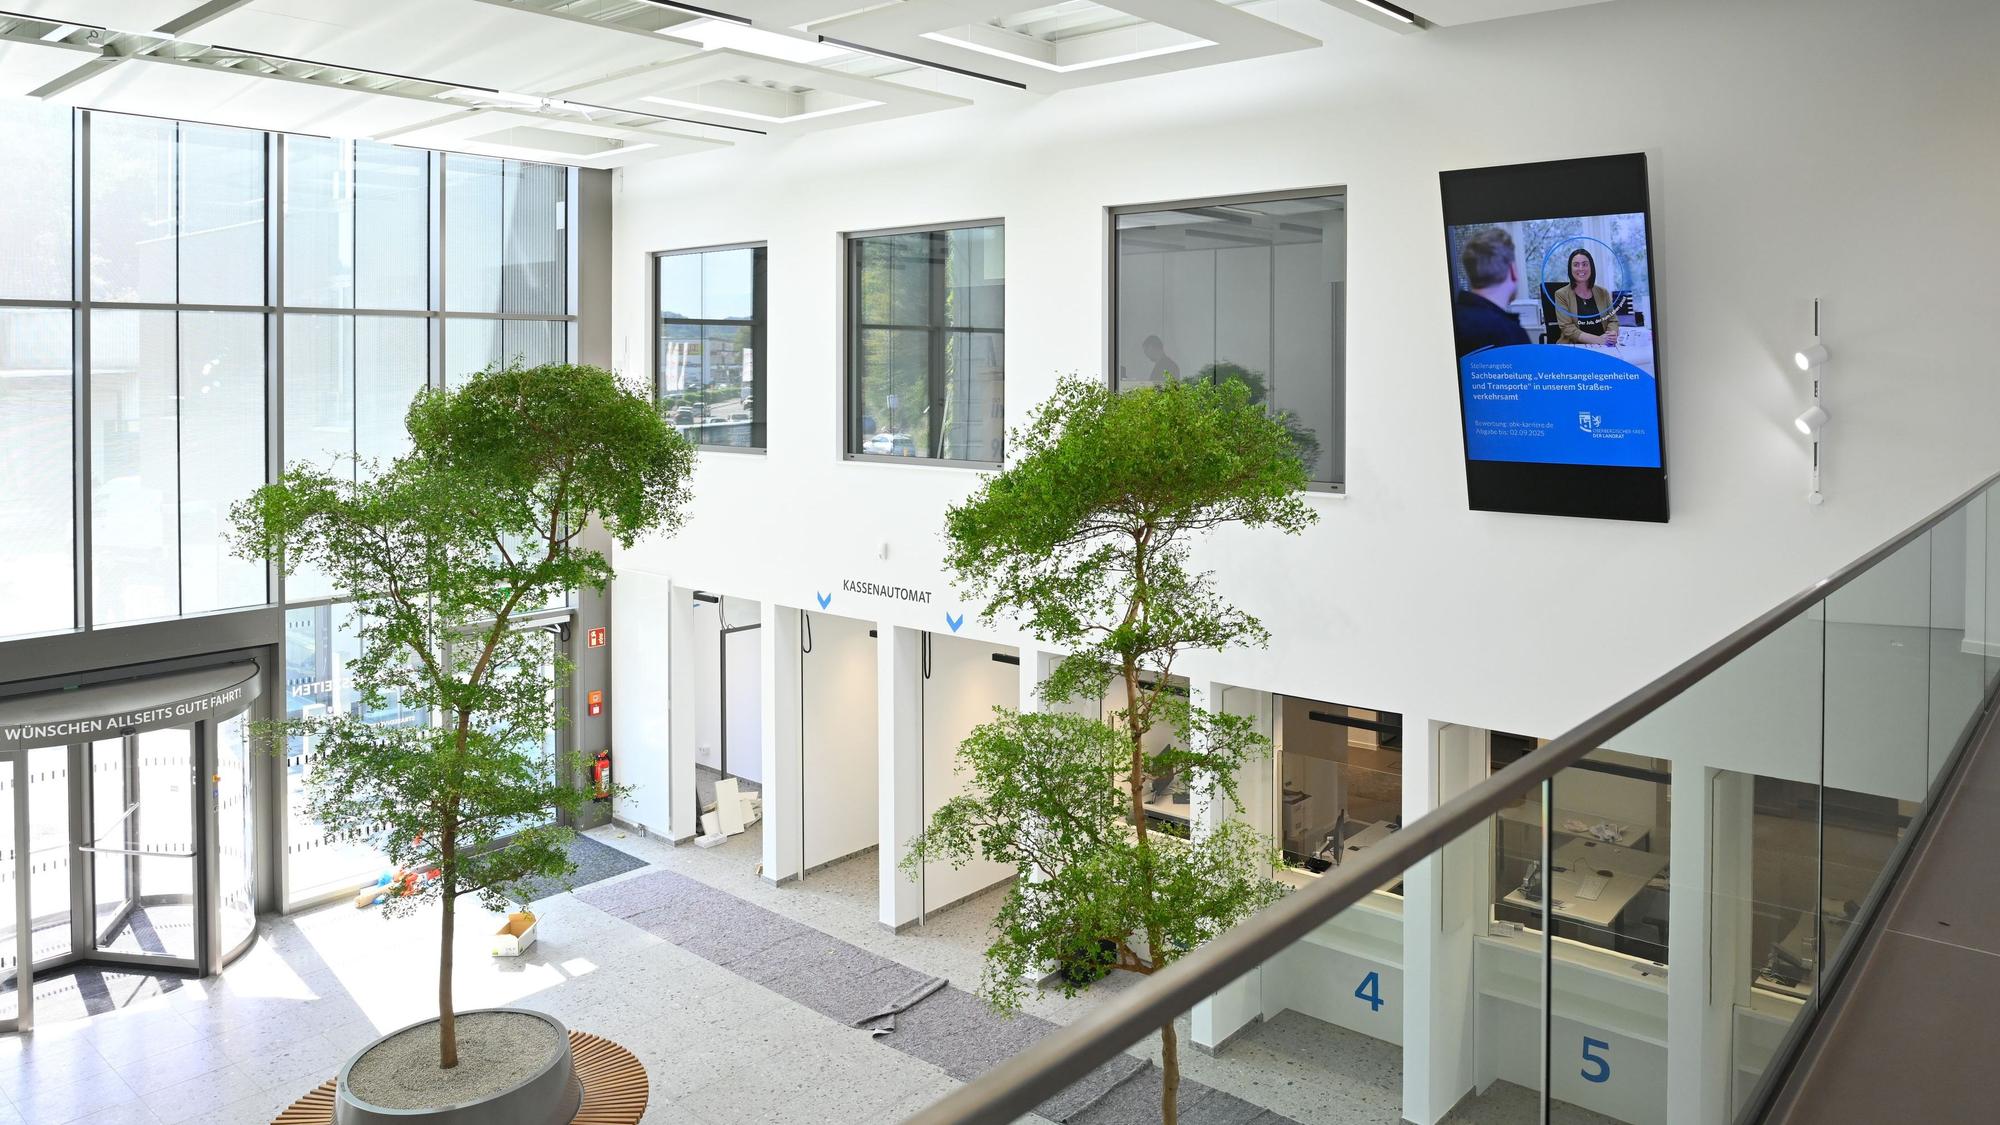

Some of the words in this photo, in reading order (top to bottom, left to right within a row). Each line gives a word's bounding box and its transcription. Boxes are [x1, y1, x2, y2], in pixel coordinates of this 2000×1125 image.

[1470, 362, 1513, 370] Stellenangebot
[1471, 371, 1533, 381] Sachbearbeitung
[1472, 382, 1486, 390] und
[1577, 383, 1613, 391] Straßen-
[1472, 393, 1519, 401] verkehrsamt
[843, 579, 932, 604] KASSENAUTOMAT
[4, 719, 102, 741] WÜNSCHEN
[106, 707, 173, 730] ALLSEITS
[175, 699, 208, 716] GUTE
[210, 687, 242, 708] FAHRT!
[1354, 971, 1384, 1012] 4
[1581, 1036, 1610, 1083] 5
